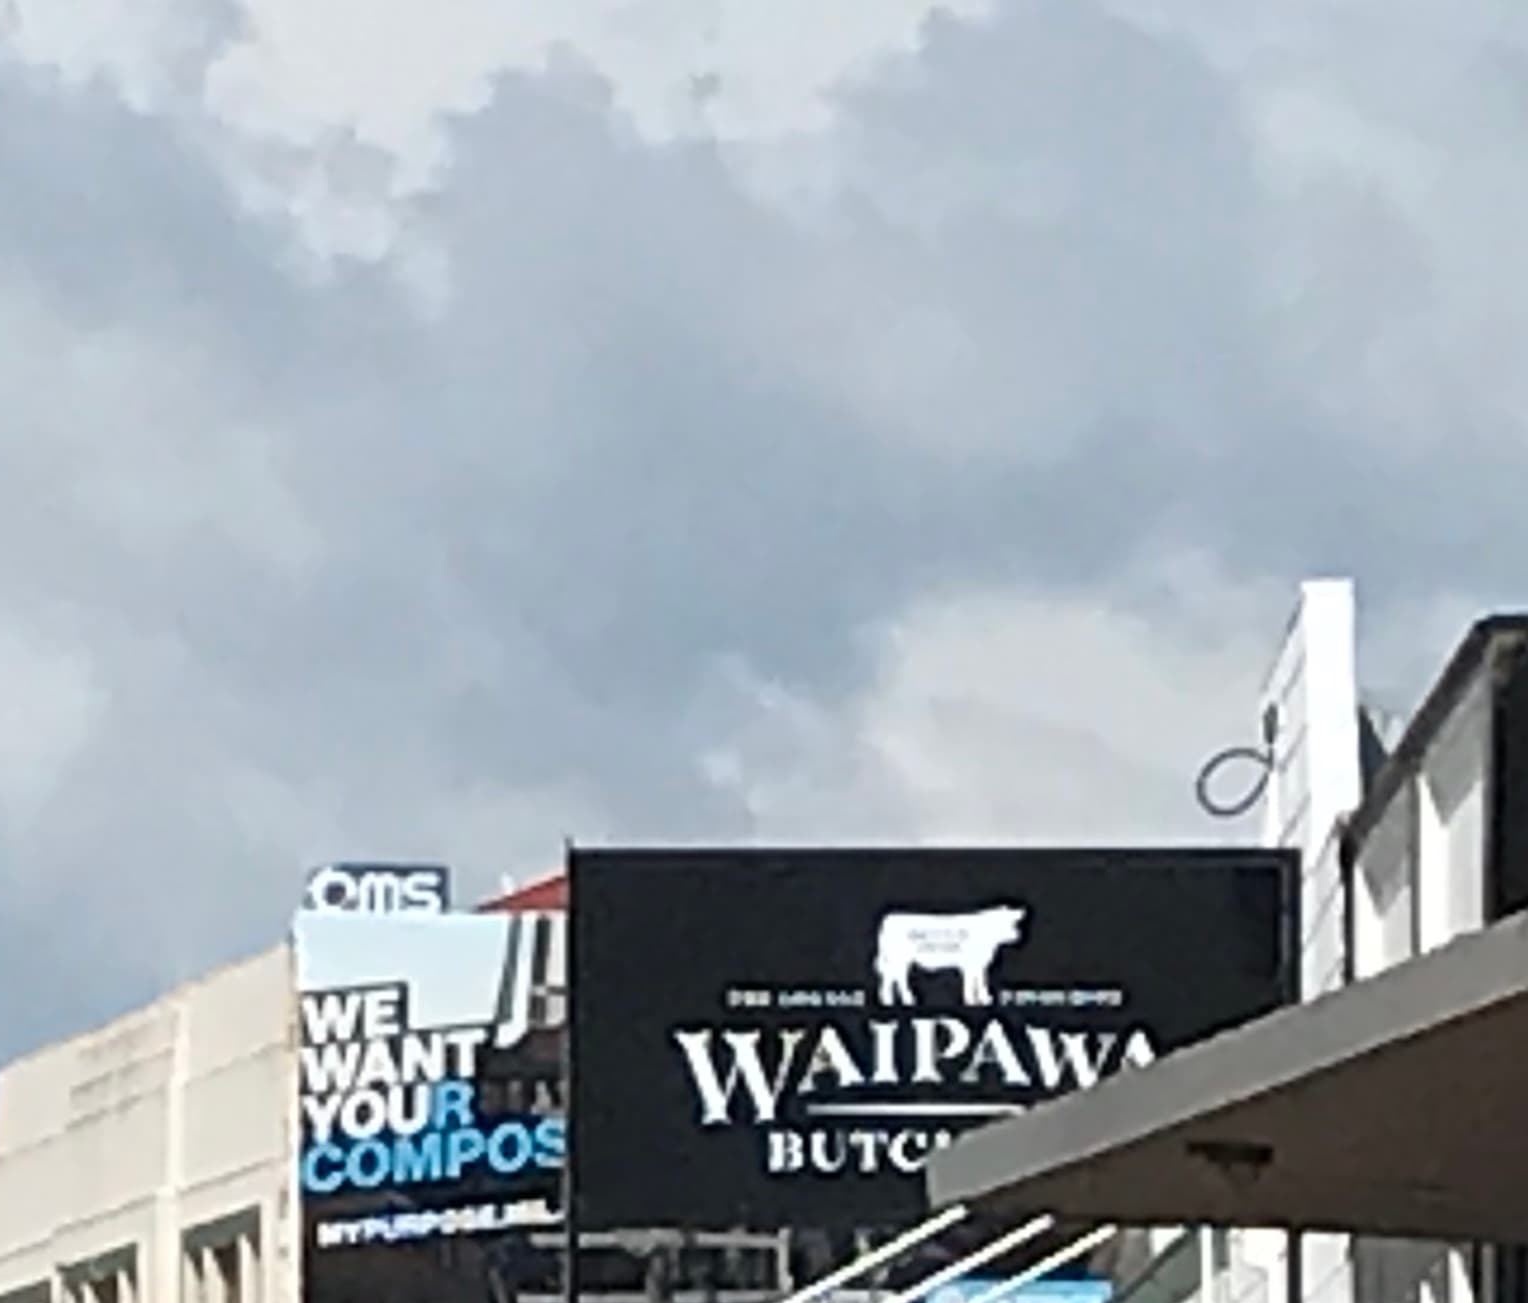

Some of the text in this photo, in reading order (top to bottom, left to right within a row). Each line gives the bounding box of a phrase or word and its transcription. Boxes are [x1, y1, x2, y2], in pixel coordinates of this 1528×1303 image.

[302, 990, 402, 1044] WE
[301, 1028, 488, 1093] WANT
[303, 1079, 475, 1144] YOUR
[768, 1127, 953, 1174] BUTC
